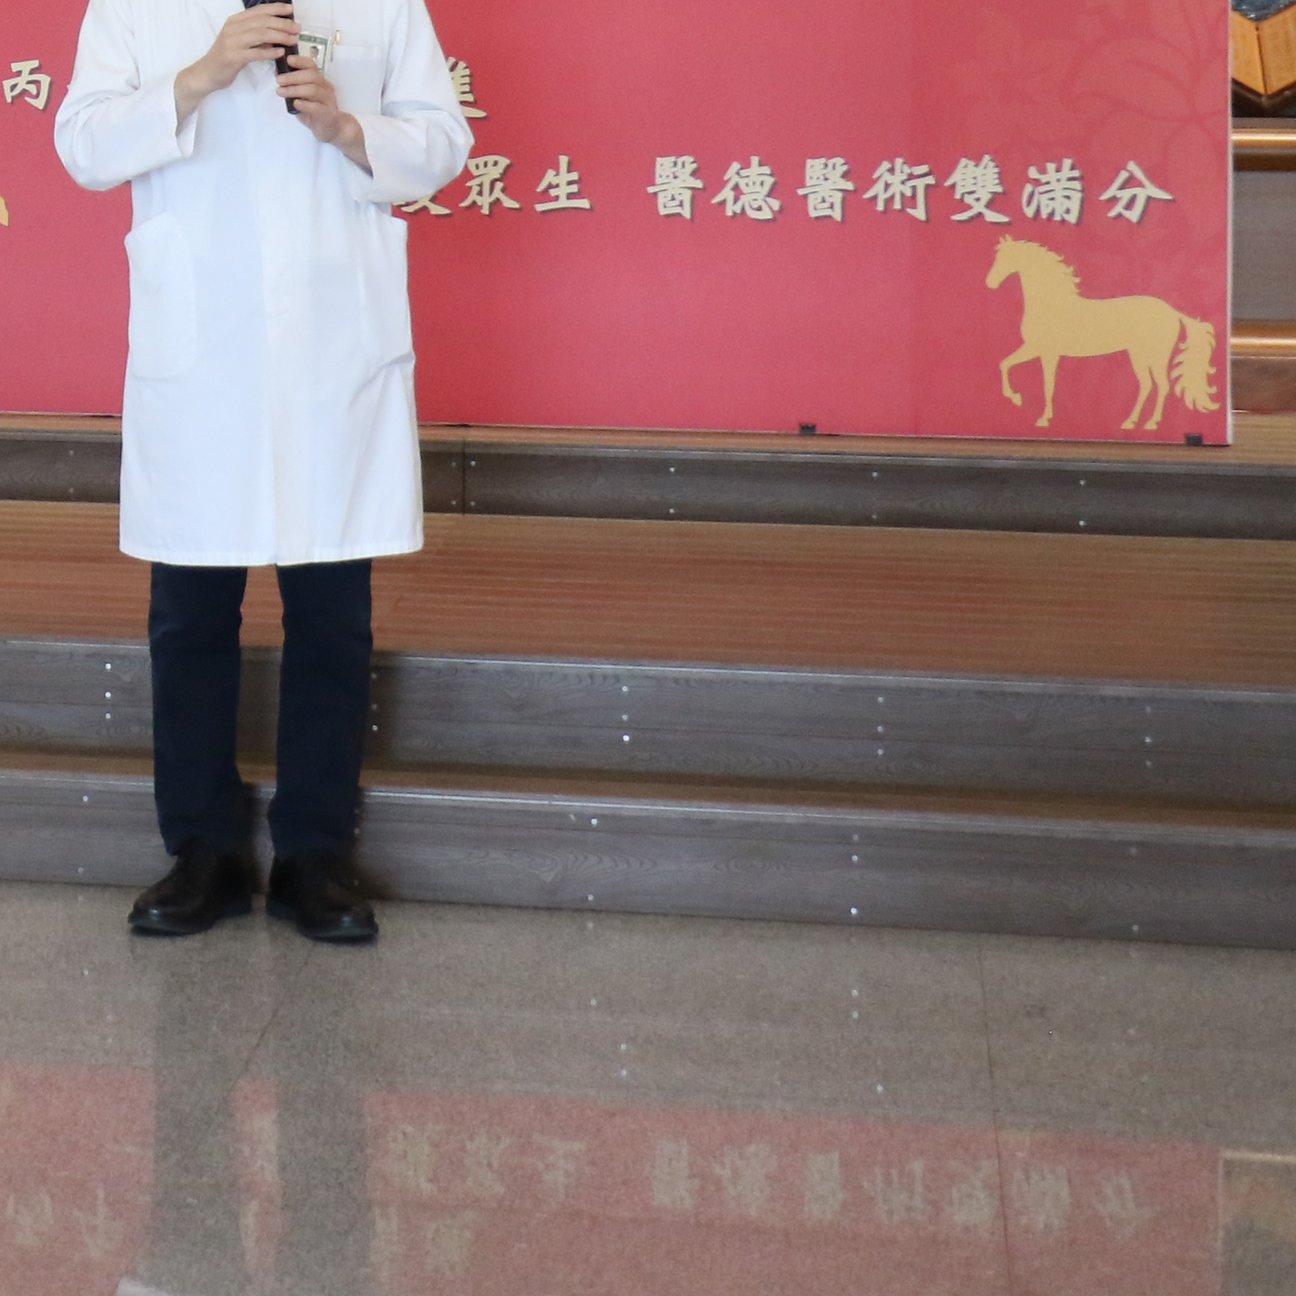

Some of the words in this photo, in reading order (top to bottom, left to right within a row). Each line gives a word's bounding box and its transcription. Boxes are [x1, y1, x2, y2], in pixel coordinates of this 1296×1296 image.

[647, 154, 1174, 224] 醫德醫術雙滿分
